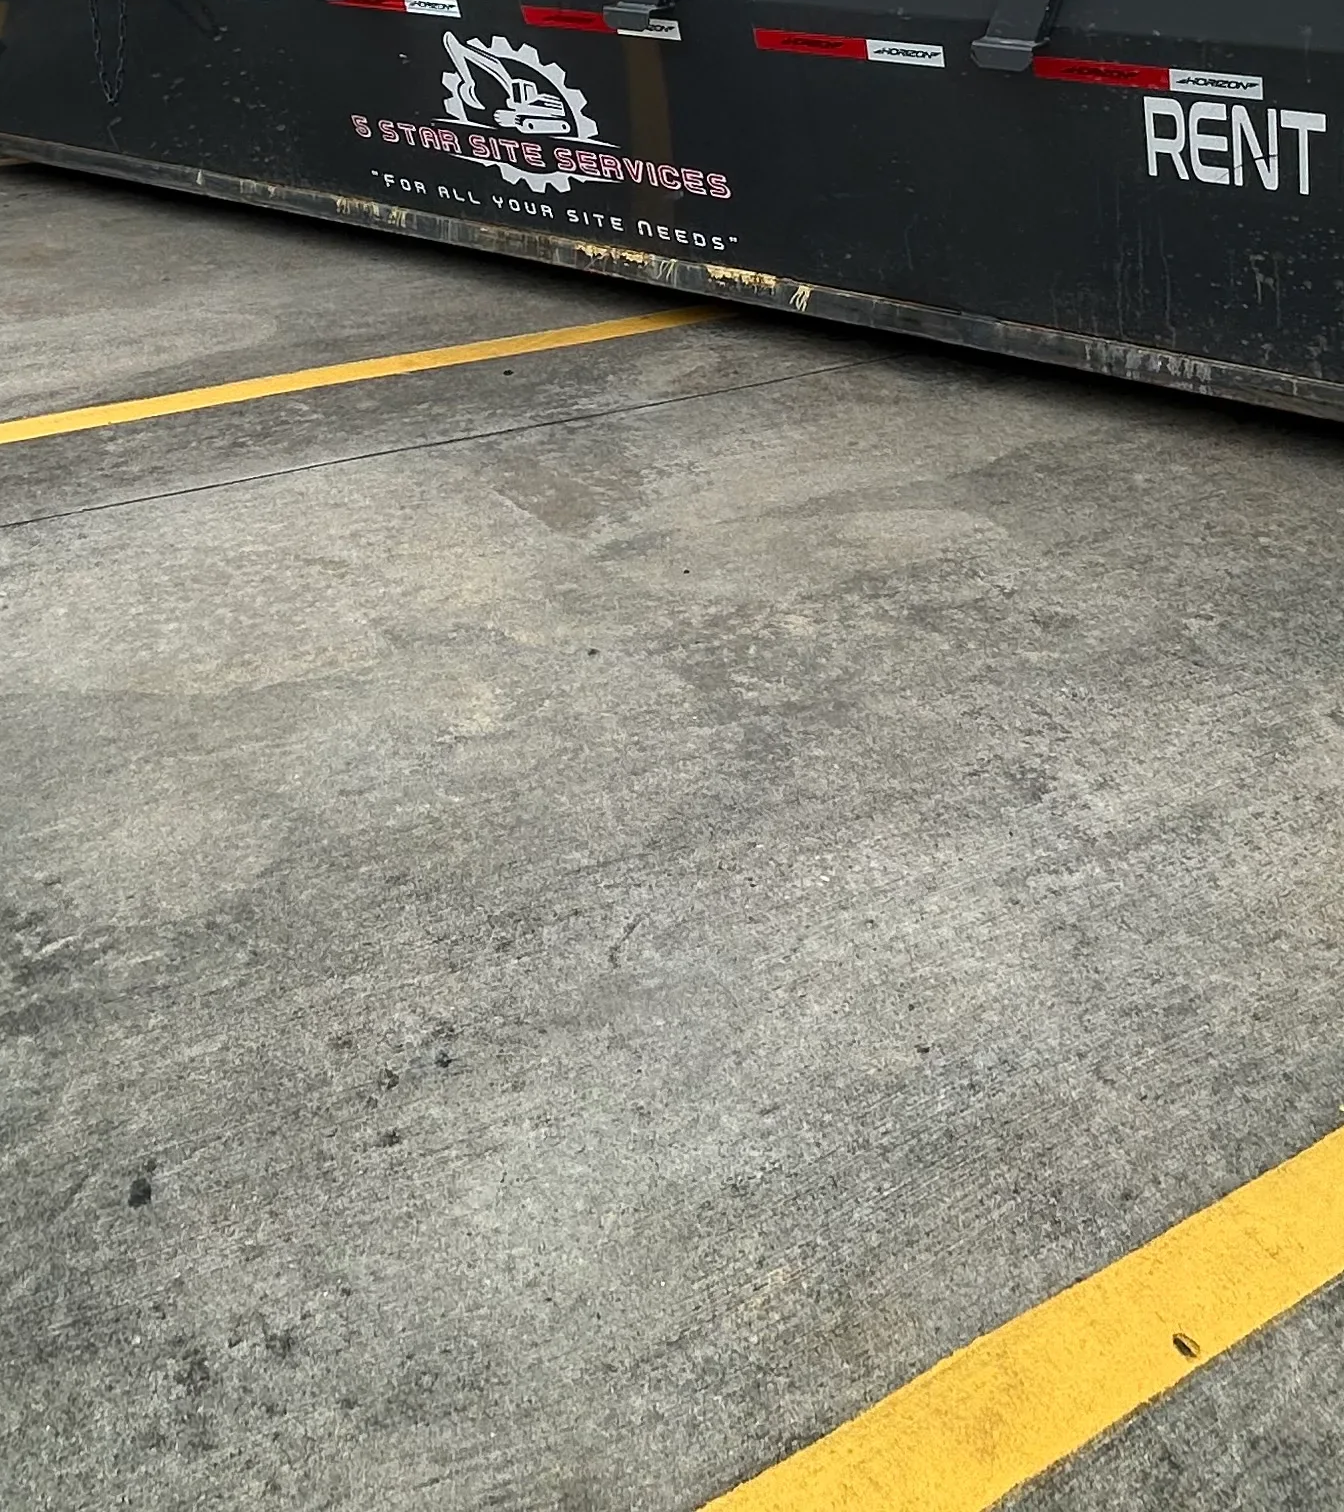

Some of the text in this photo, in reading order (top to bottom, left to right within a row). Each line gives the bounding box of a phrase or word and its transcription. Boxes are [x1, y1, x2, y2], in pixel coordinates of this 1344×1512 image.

[873, 46, 941, 60] HORIZON
[1175, 76, 1260, 92] HORIZON
[350, 115, 733, 200] 5 STAR SITE SERVICES
[1143, 96, 1327, 195] RENT
[371, 169, 739, 251] "FOR ALL YOUR SITE NEEDS"
